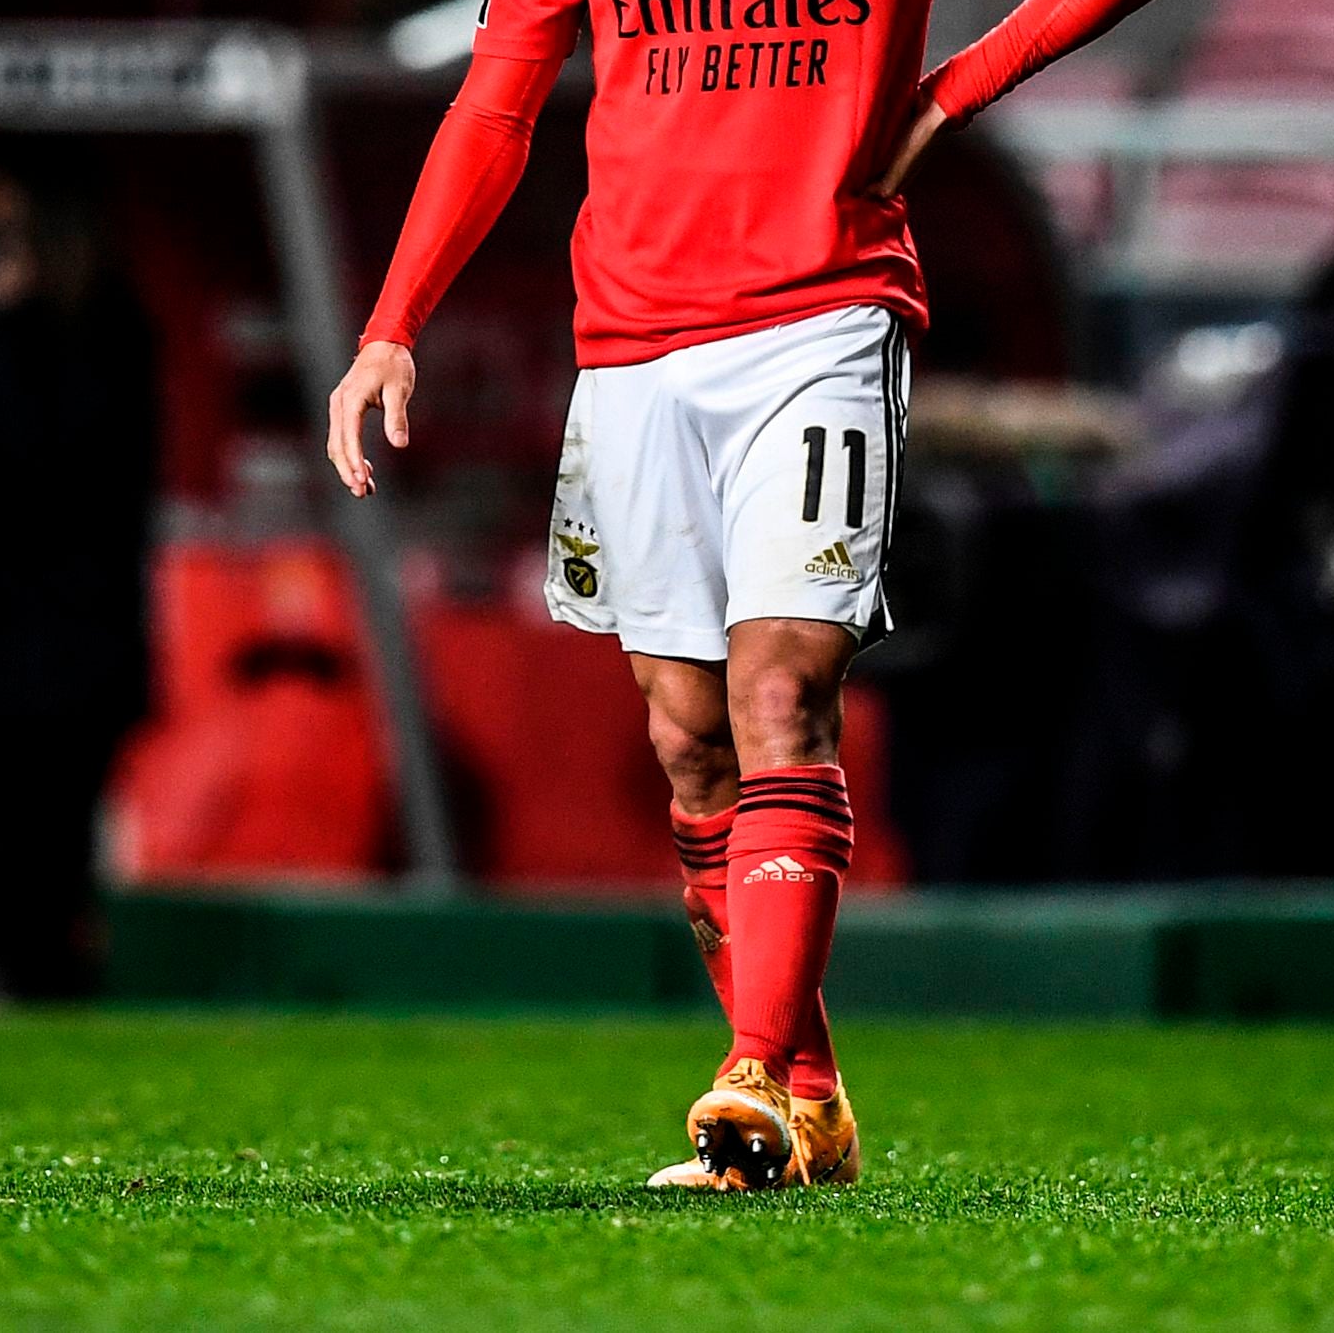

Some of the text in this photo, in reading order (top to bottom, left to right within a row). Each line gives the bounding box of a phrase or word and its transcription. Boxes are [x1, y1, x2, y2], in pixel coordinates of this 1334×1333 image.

[645, 39, 829, 95] FLY BETTER
[802, 425, 867, 529] 11
[804, 560, 860, 581] adidas
[743, 868, 815, 884] adidas
